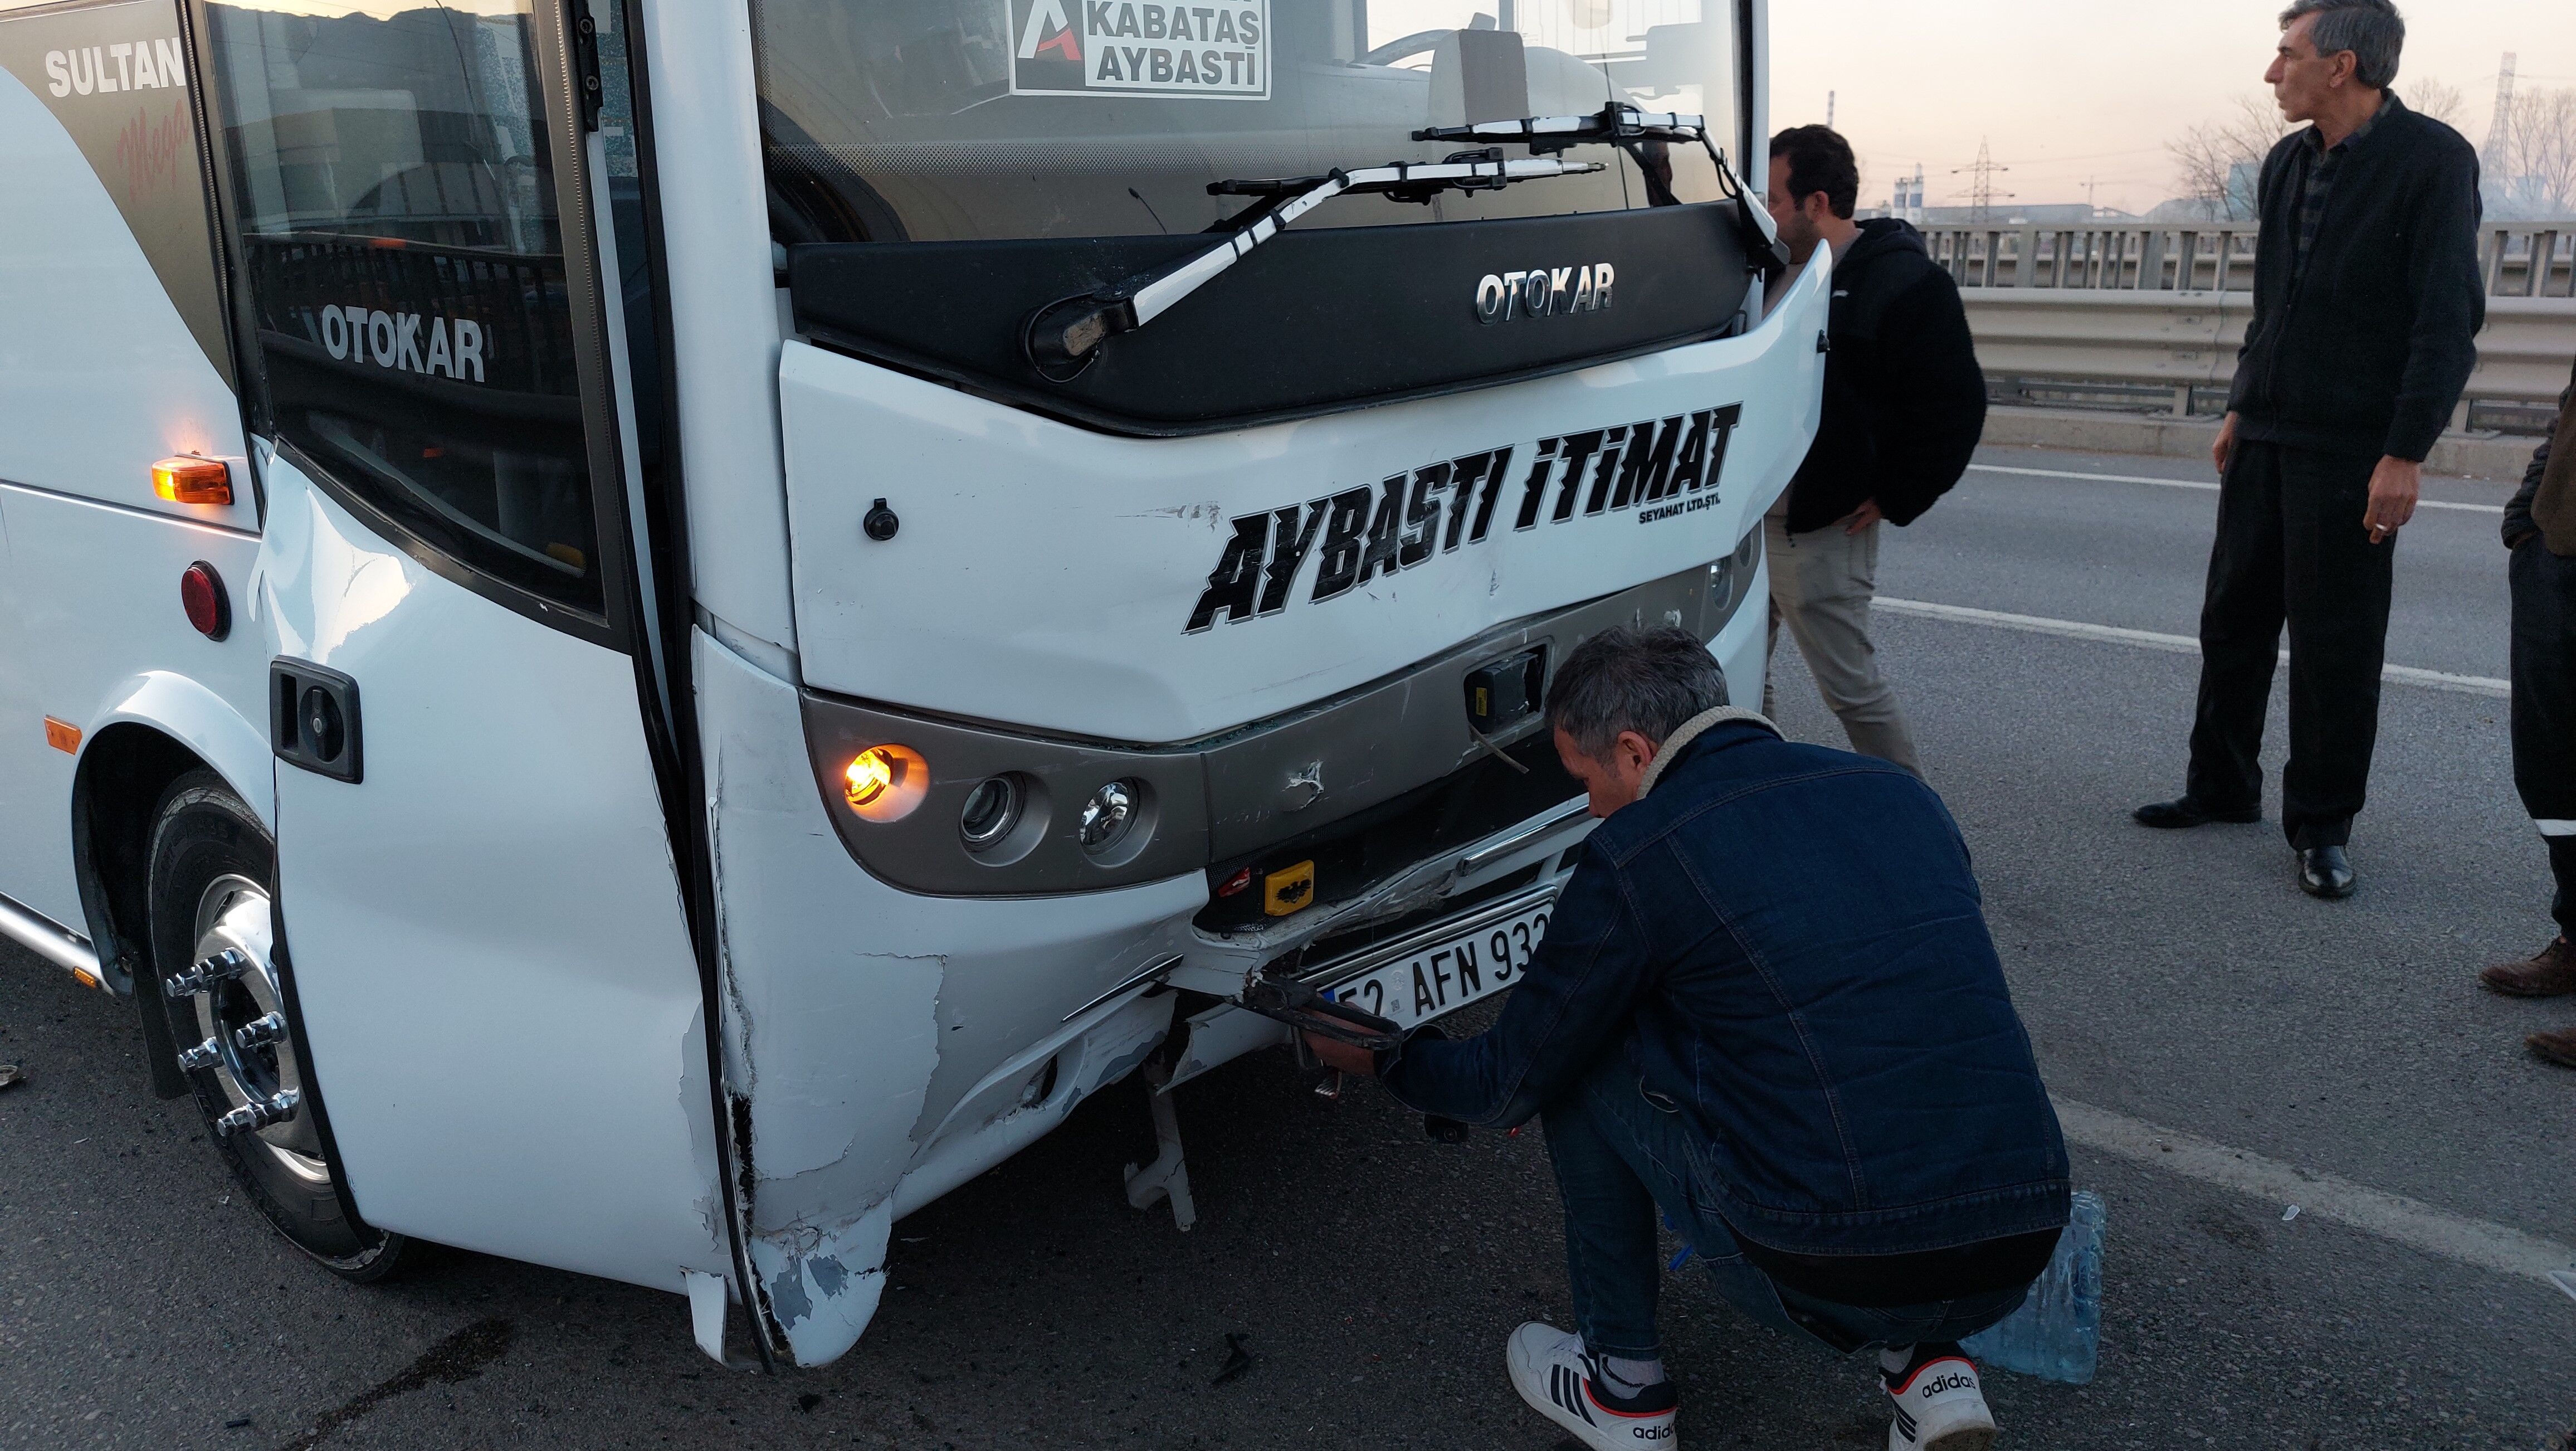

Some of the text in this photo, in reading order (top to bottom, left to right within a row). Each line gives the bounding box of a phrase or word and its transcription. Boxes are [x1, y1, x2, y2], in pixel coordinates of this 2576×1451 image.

[45, 37, 187, 98] SULTAN
[1477, 263, 1614, 325] OTOKAR
[322, 304, 485, 383] OTOKAR
[1181, 444, 1515, 635] AYBASTI
[1639, 501, 1685, 524] SEYAHAT
[1339, 979, 1383, 1017] 2
[1412, 942, 1482, 1016] AFN
